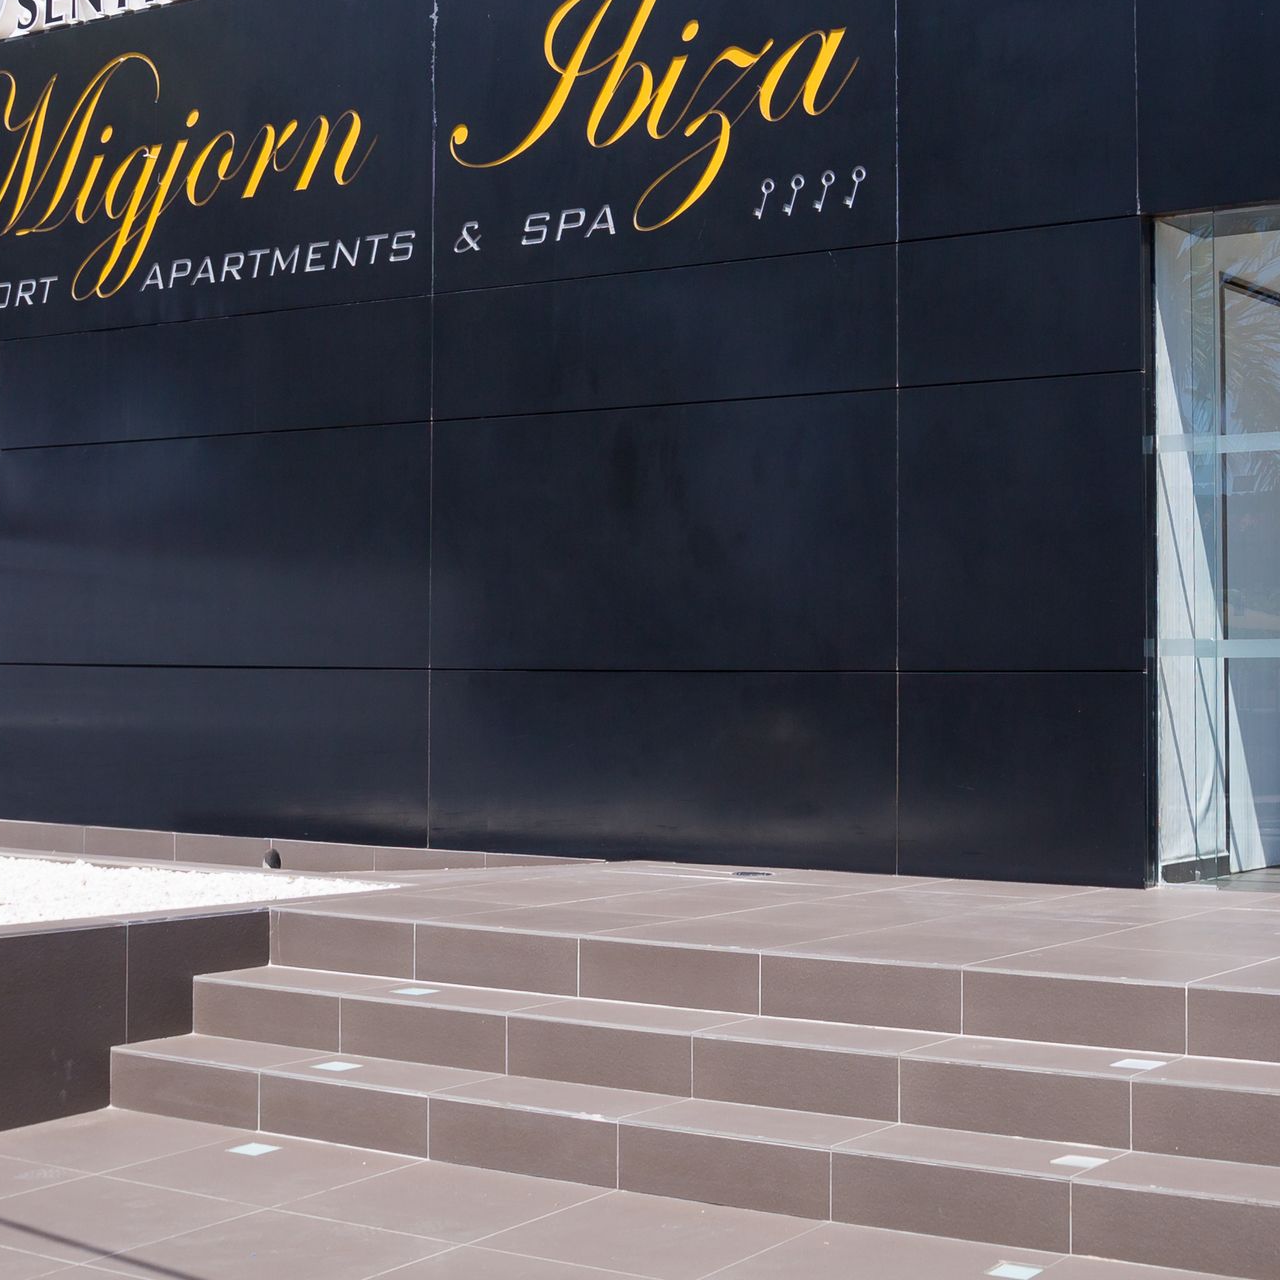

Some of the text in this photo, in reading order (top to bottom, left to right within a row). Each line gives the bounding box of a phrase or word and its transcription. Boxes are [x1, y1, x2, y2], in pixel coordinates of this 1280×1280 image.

[140, 230, 416, 292] APARTMENTS
[454, 221, 482, 253] &
[521, 204, 617, 245] SPA
